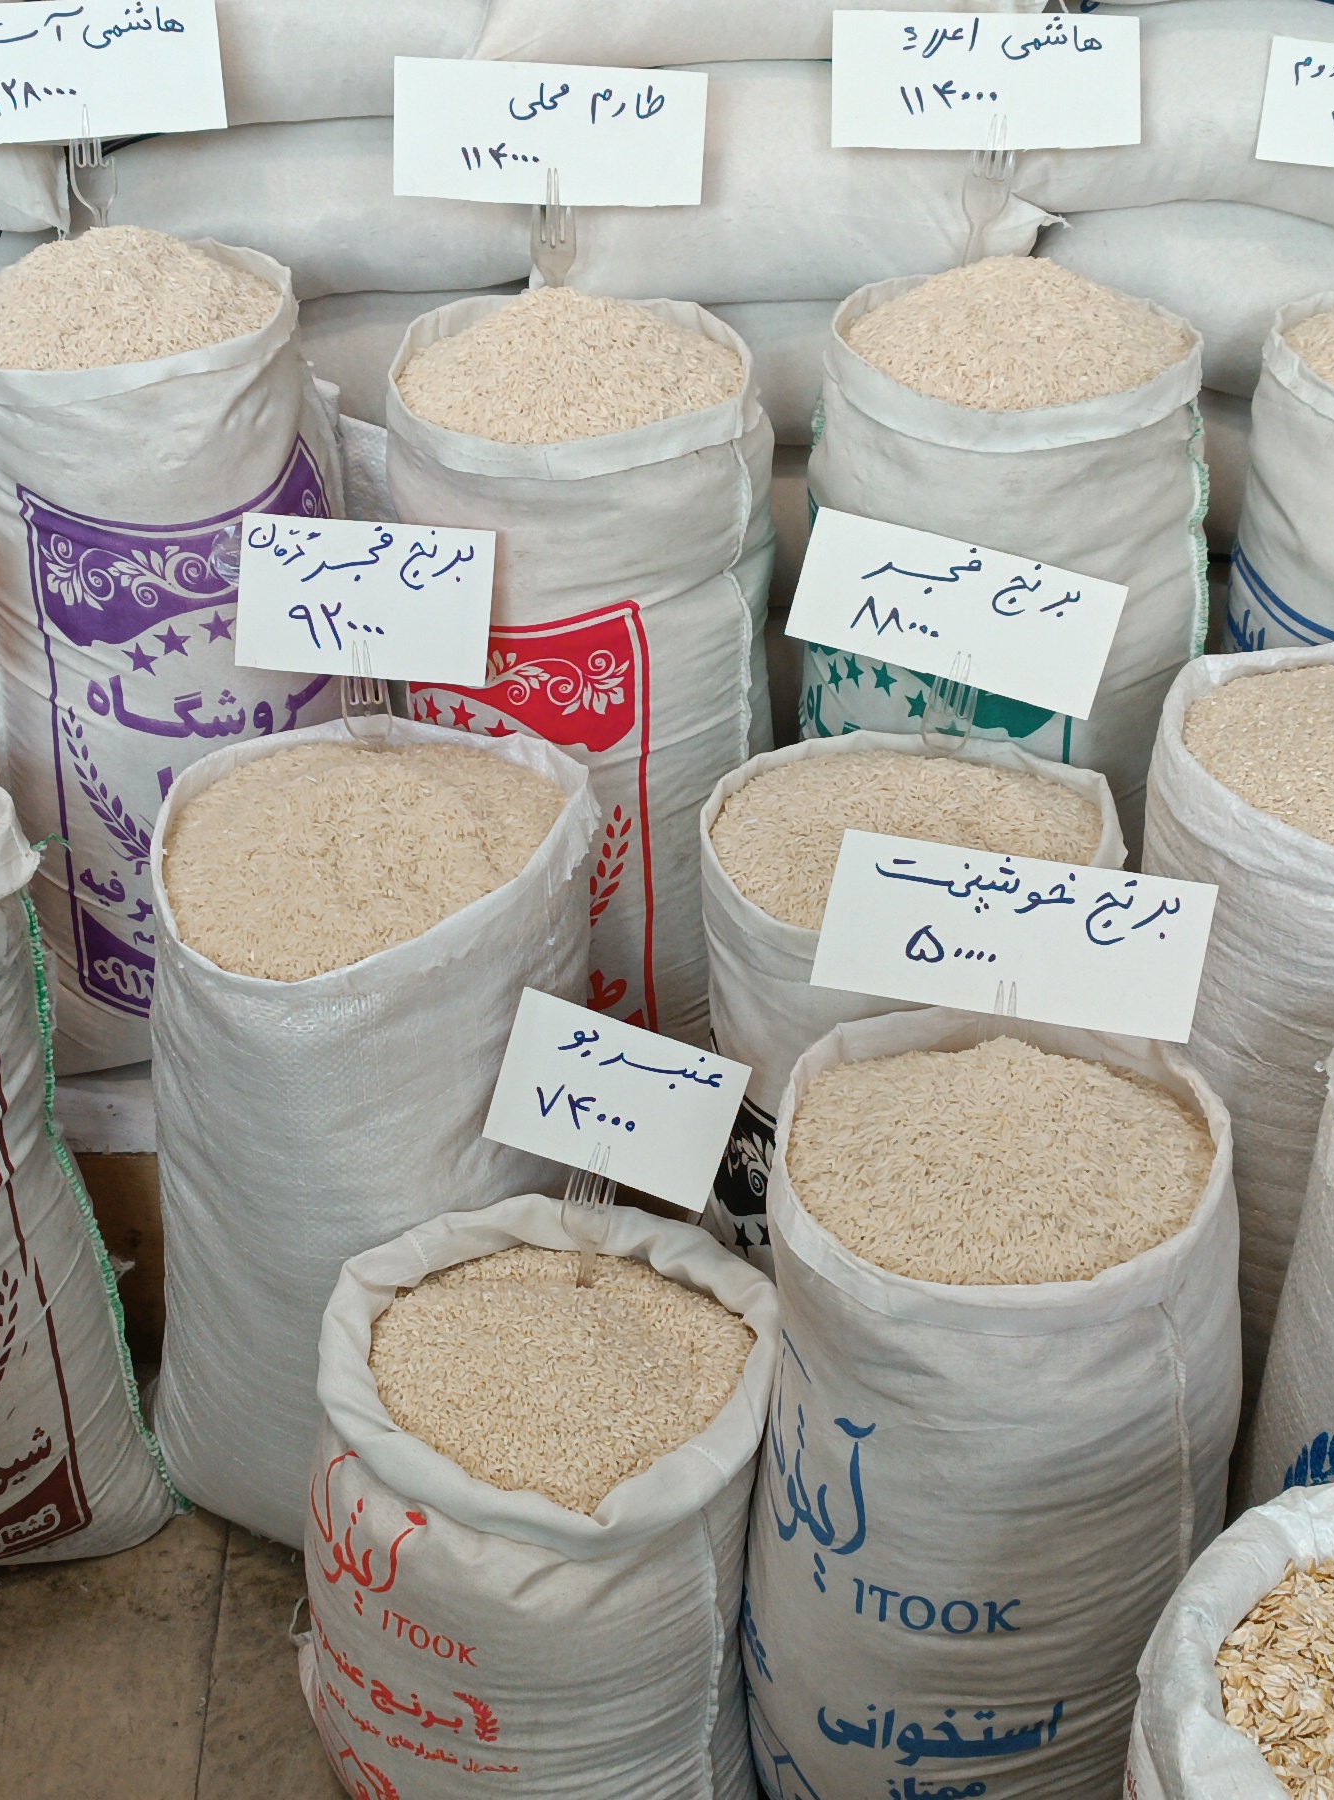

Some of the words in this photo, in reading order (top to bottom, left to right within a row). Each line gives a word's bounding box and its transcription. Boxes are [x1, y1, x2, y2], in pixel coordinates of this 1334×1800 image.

[83, 2, 184, 49] هاشمی
[1001, 16, 1102, 60] هاشمی
[509, 83, 569, 120] محلی
[591, 85, 664, 124] طارم
[900, 80, 997, 115] ۱۱۴۰۰۰
[462, 143, 539, 170] ۱۱۴۰۰۰
[301, 526, 393, 582] فجر
[400, 530, 474, 590] برنج
[861, 548, 982, 594] فجر
[992, 563, 1081, 617] برنج
[289, 602, 384, 650] ۹۲۰۰۰
[850, 596, 939, 637] ۸۸۰۰۰
[1086, 880, 1180, 945] برنج
[905, 925, 996, 963] ۵۰۰۰۰
[558, 1030, 599, 1057] بو
[599, 1053, 723, 1089] عنبر
[537, 1084, 635, 1132] ۷۴۰۰۰
[853, 1577, 1021, 1635] ITOOK
[382, 1609, 478, 1668] ITOOK
[371, 1679, 464, 1734] برنج
[818, 1700, 1065, 1767] استخوانی
